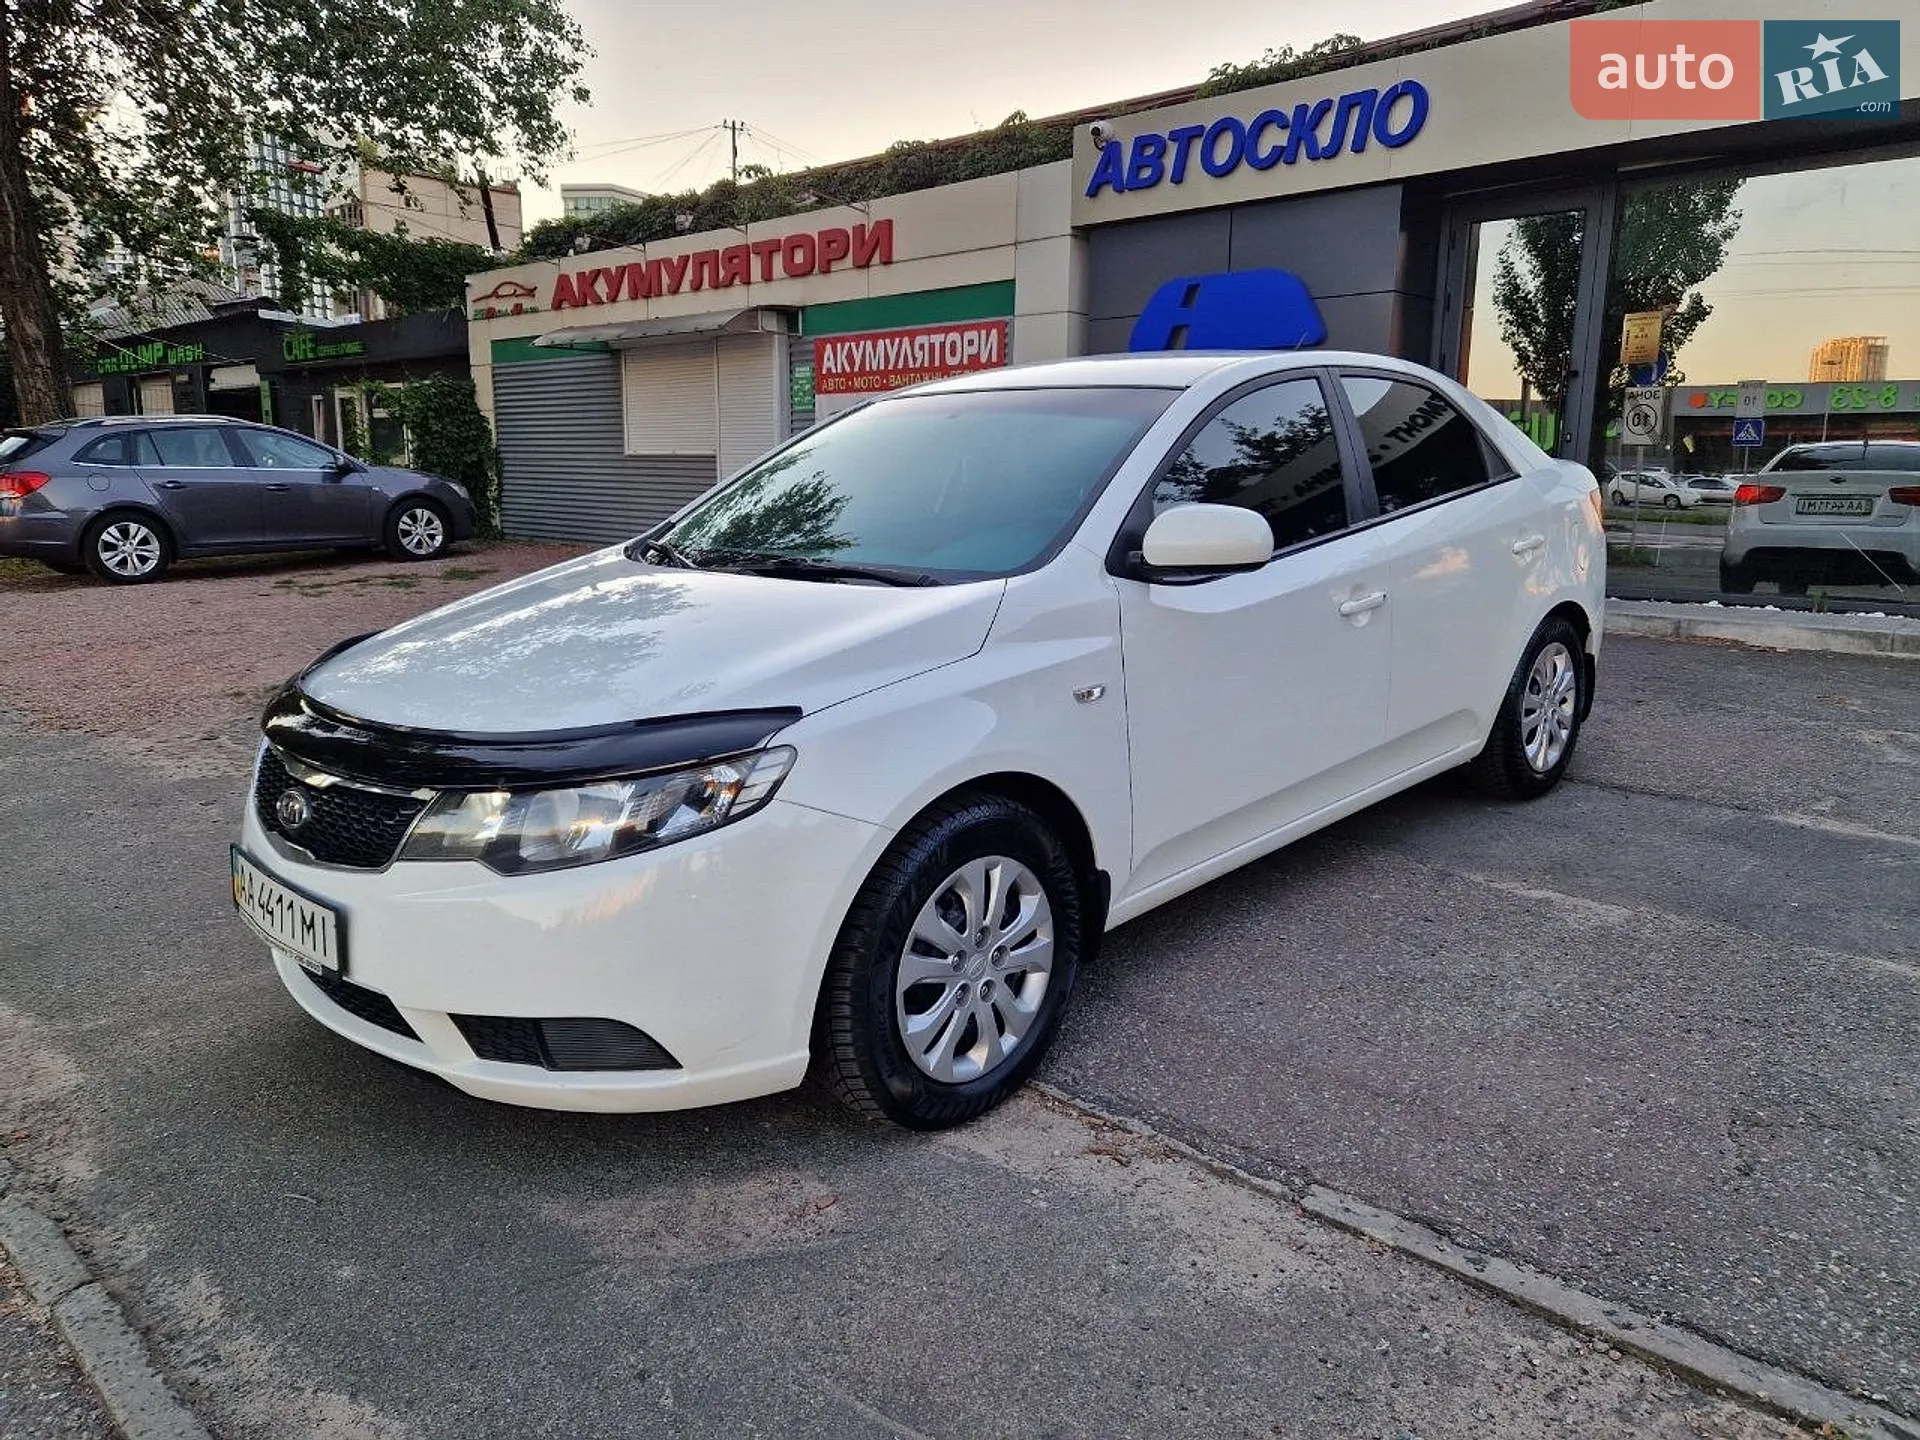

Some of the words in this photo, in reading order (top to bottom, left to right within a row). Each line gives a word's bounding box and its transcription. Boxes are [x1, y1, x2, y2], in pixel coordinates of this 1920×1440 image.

[1085, 79, 1430, 198] АВТОСКЛО
[550, 218, 894, 311] АКУМУЛЯТОРИ
[822, 328, 998, 375] АКУМУЛЯТОРИ
[822, 376, 846, 392] АВТО
[853, 374, 882, 390] МОТО
